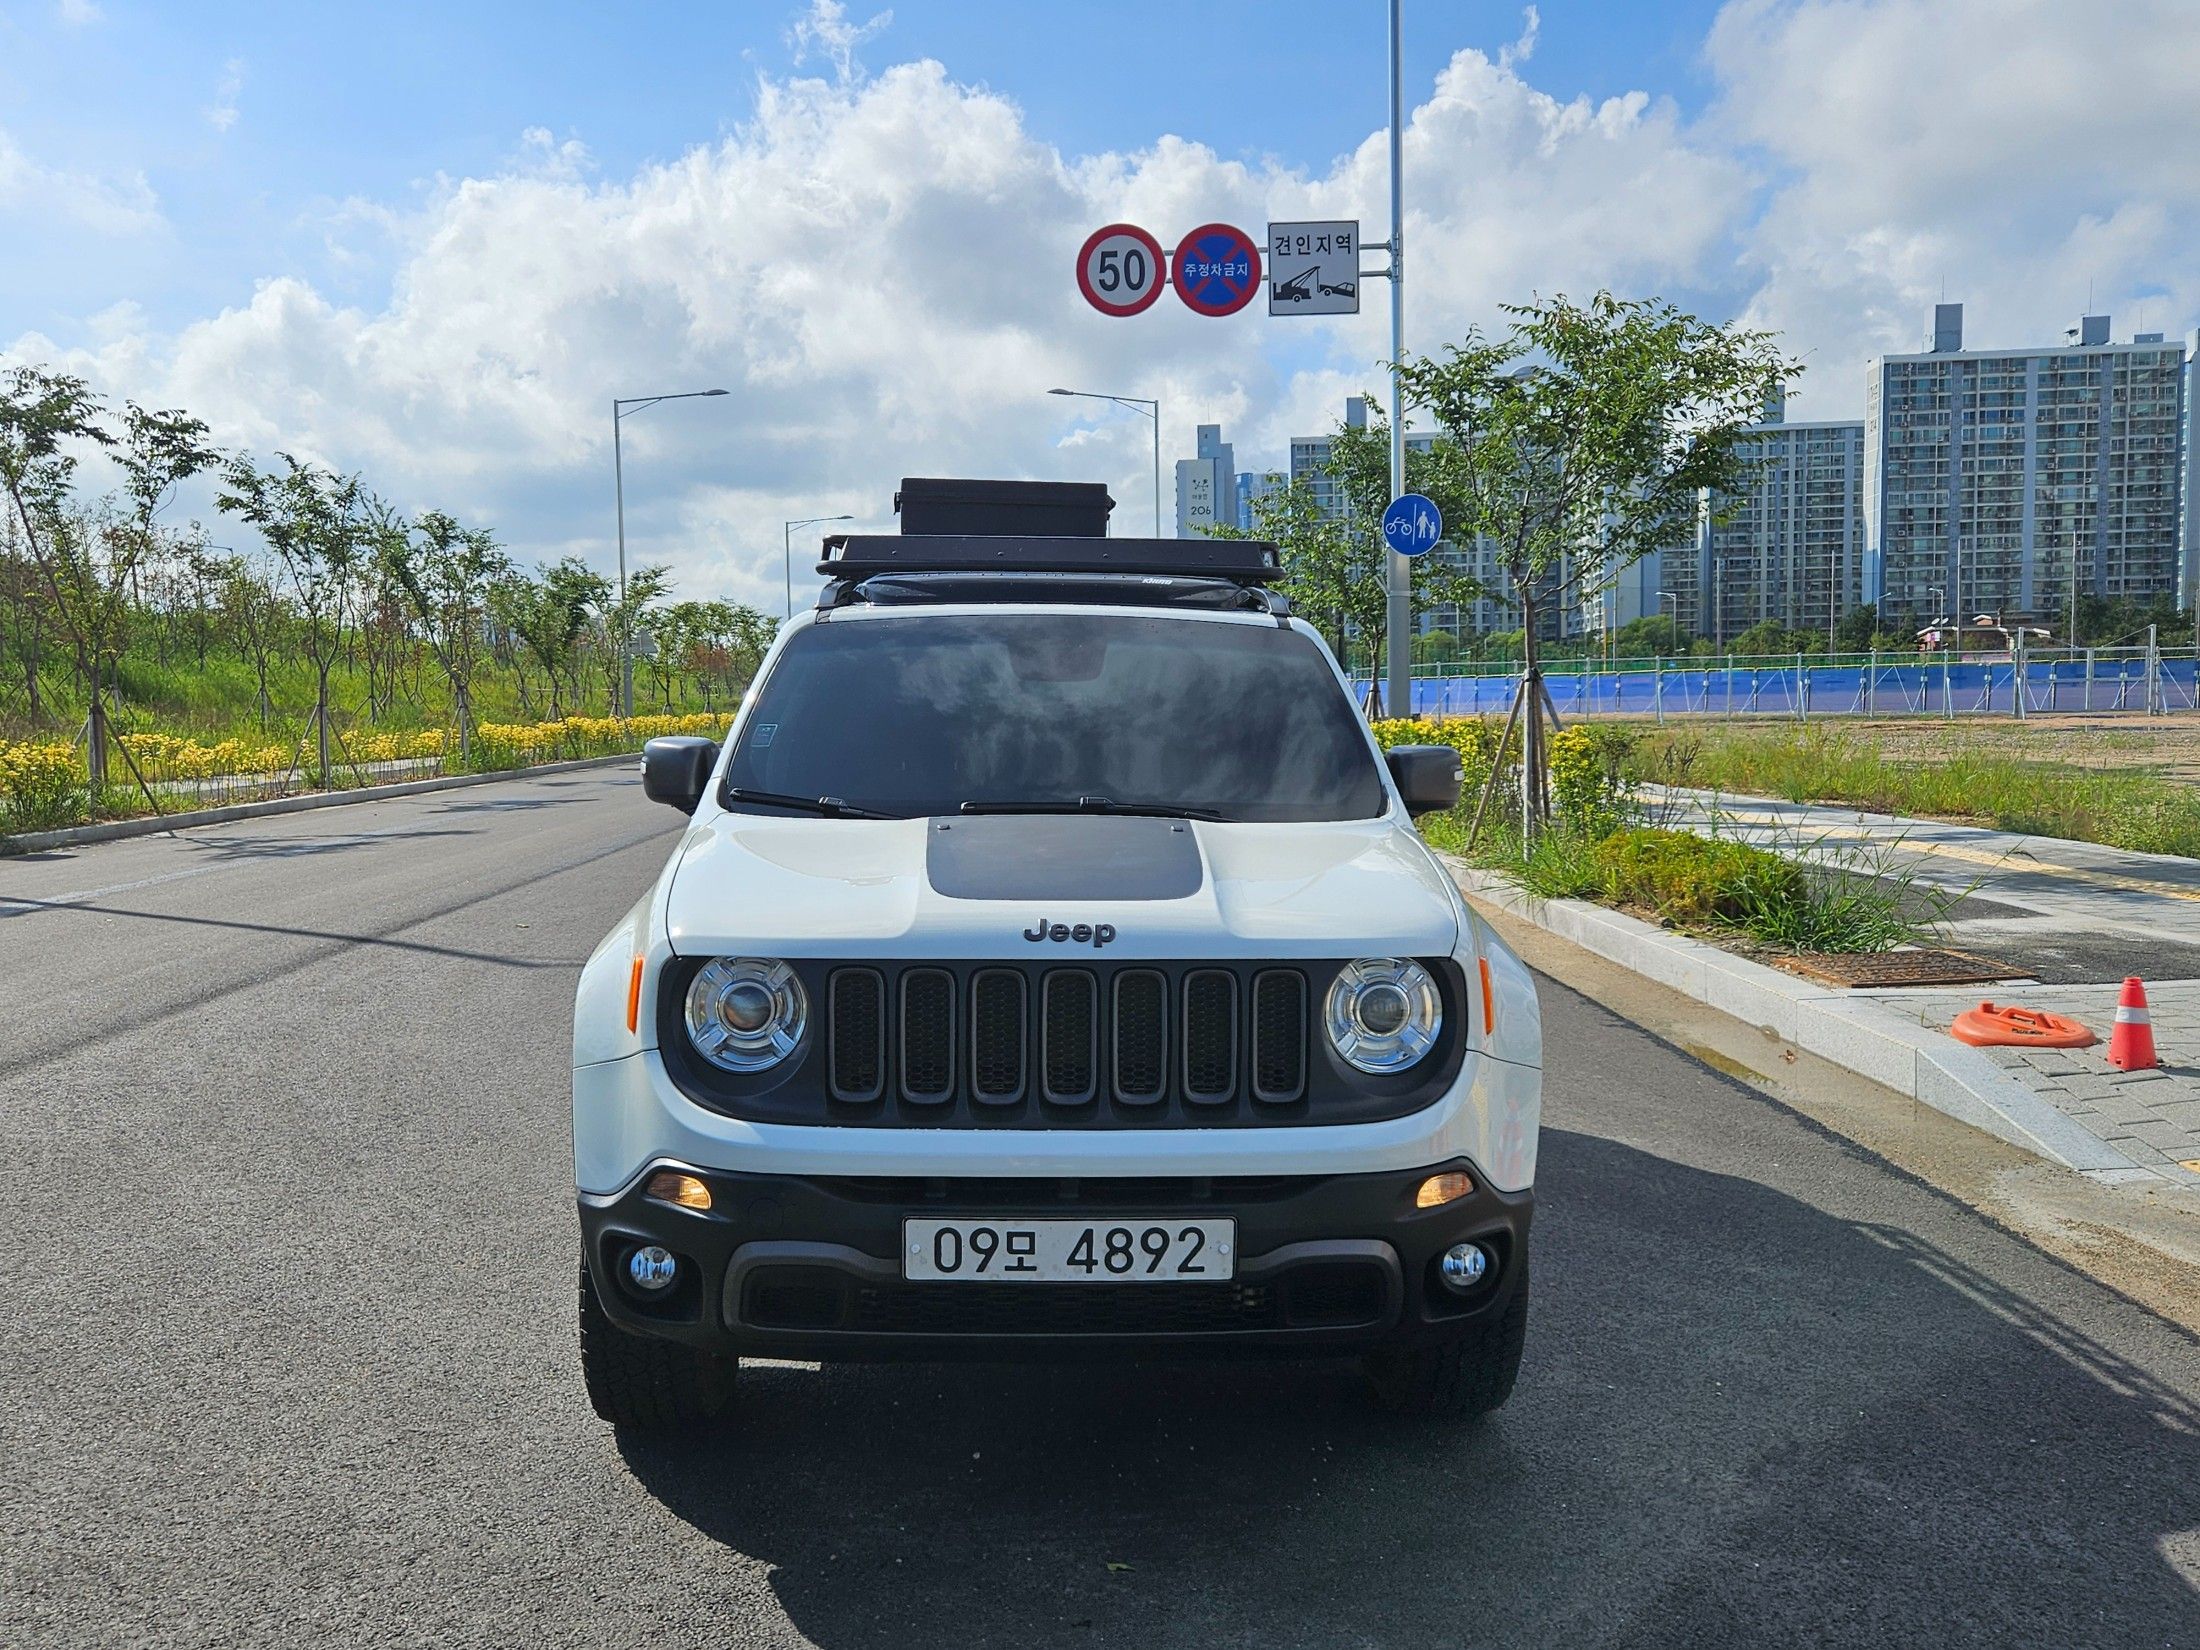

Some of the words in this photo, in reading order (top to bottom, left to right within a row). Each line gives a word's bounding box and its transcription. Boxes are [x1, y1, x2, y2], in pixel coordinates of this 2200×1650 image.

[1275, 233, 1351, 256] 견인지역
[1098, 249, 1146, 291] 50
[1184, 262, 1248, 277] 주정차금지
[1190, 505, 1212, 516] 206
[1023, 918, 1117, 949] Jeep
[933, 1226, 1038, 1273] 09모
[1066, 1227, 1206, 1274] 4892
